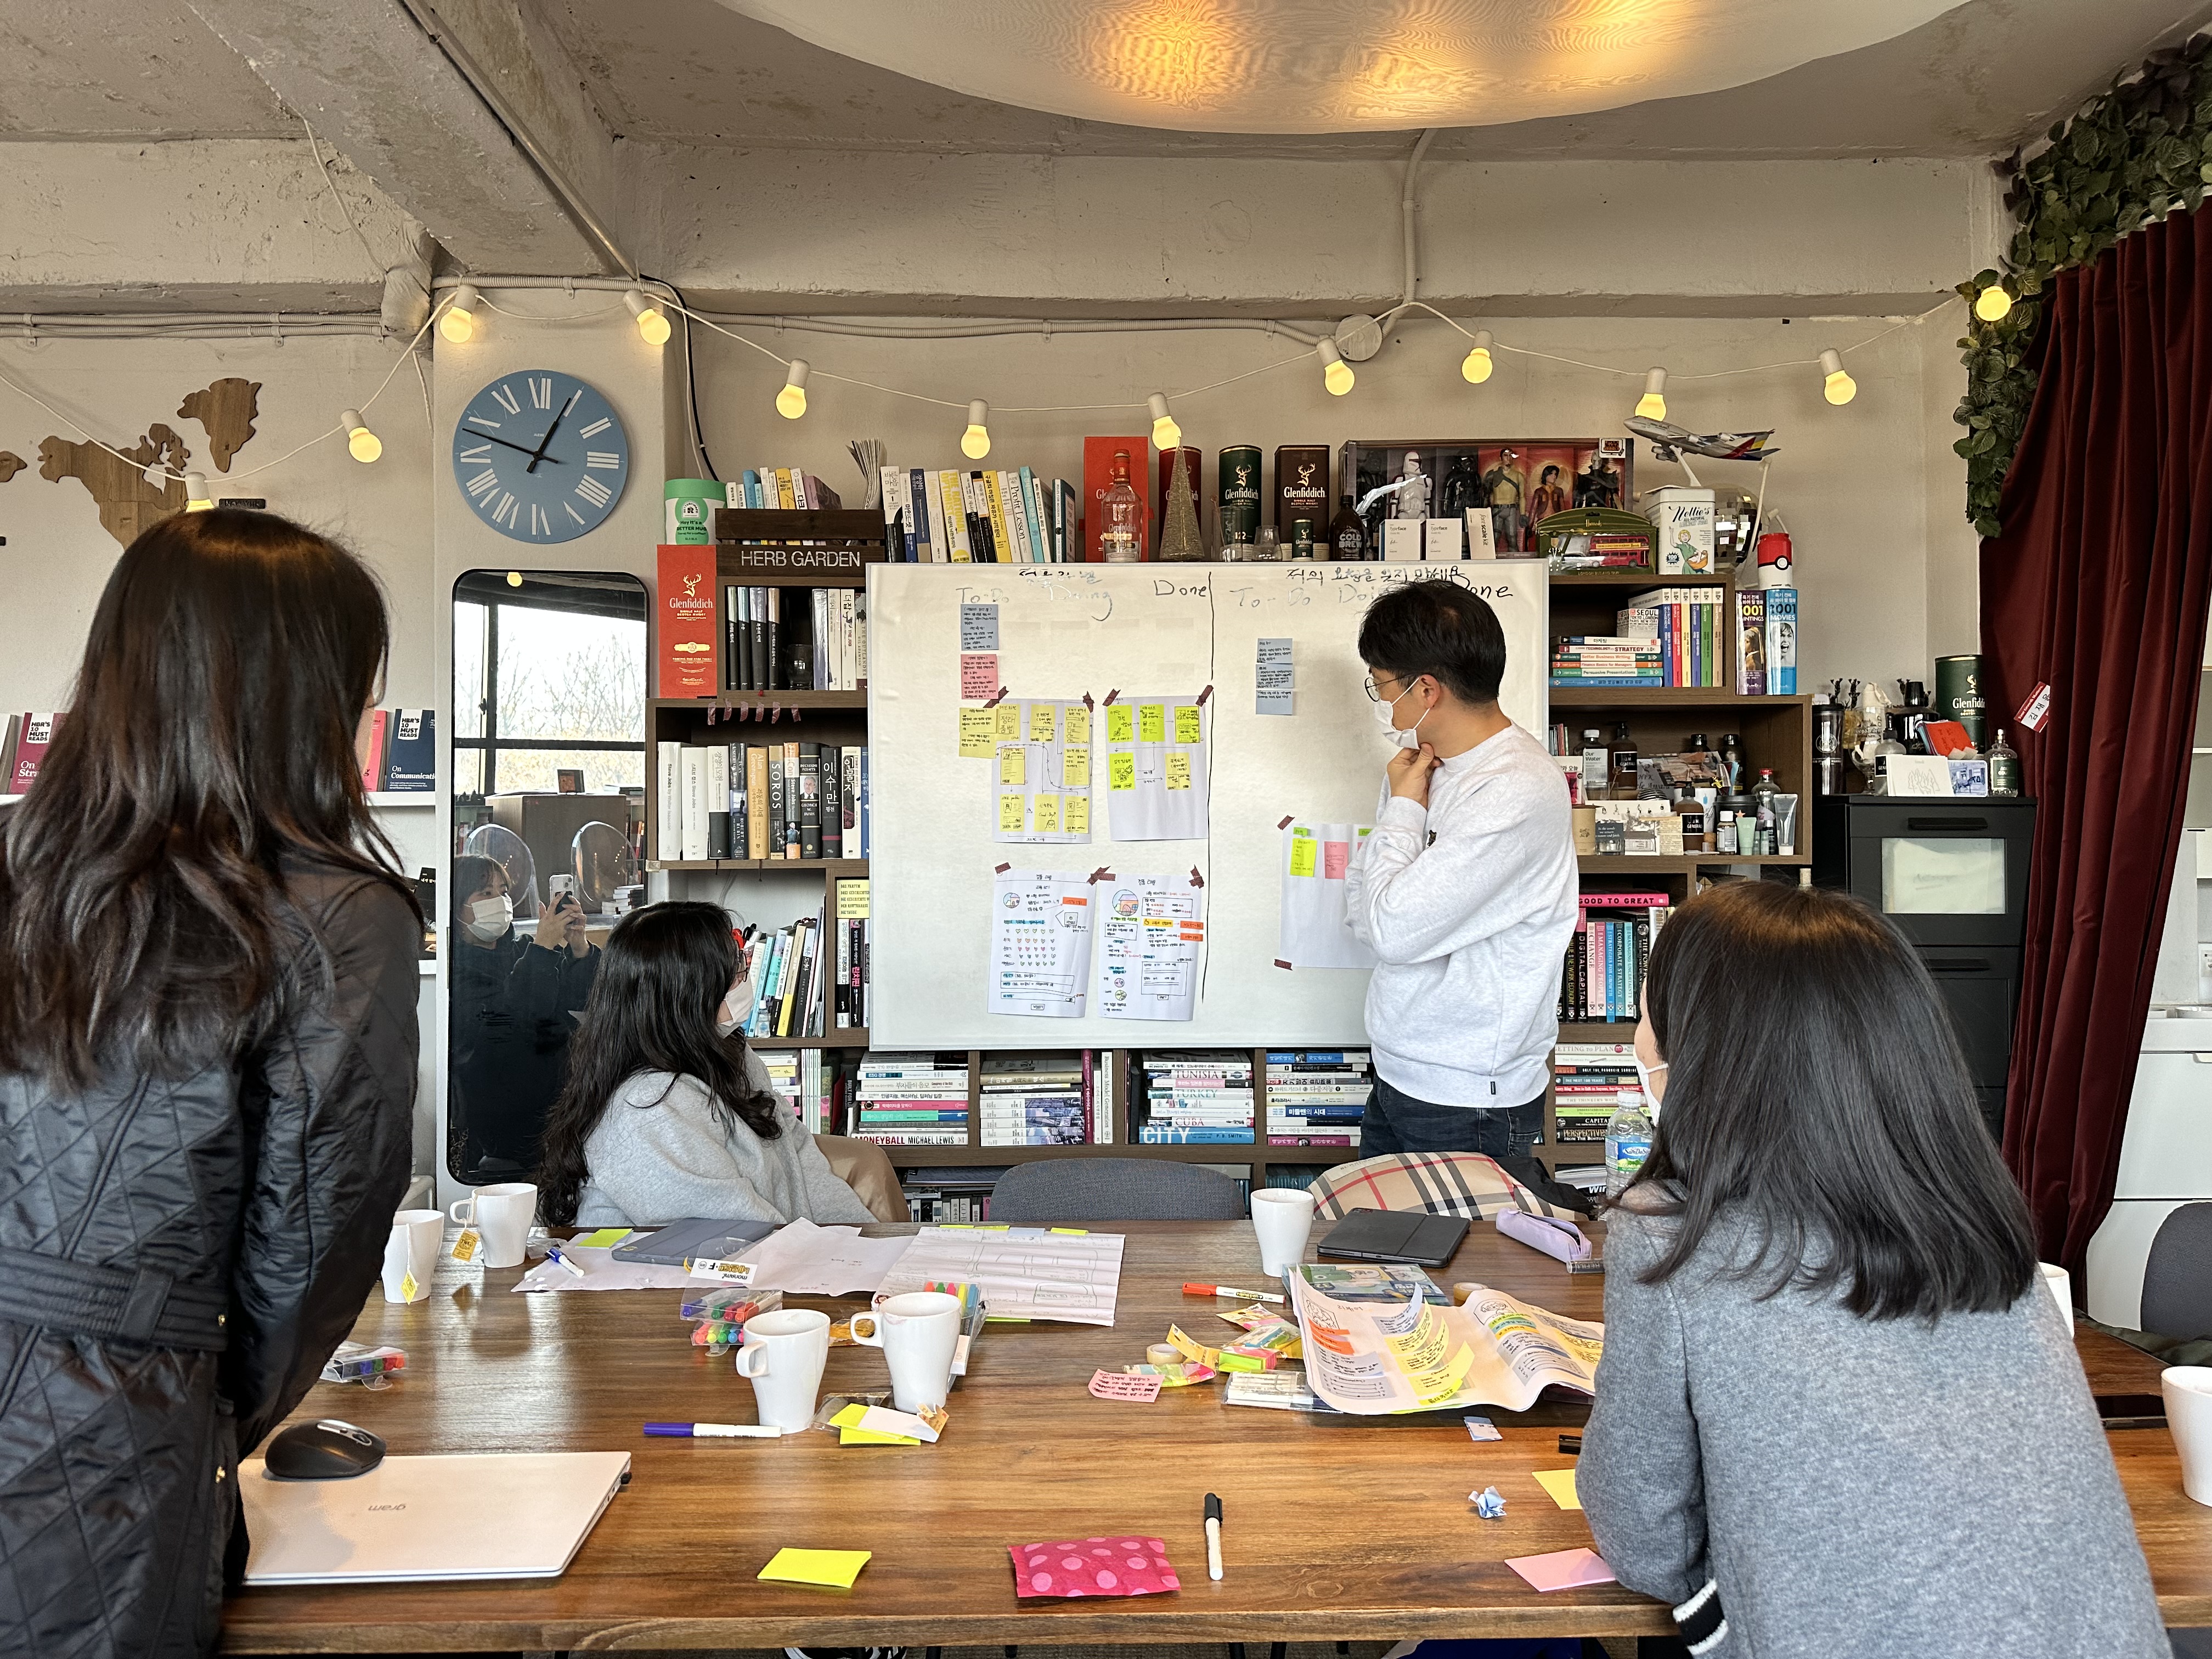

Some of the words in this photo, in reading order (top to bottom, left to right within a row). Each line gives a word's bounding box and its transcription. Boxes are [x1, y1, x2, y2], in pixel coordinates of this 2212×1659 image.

[950, 471, 958, 488] THE
[941, 472, 955, 516] OPTIMIST
[1011, 486, 1020, 509] Profit
[1225, 487, 1259, 500] Glenfiddich
[1284, 487, 1325, 498] Glenfiddich
[952, 491, 965, 533] RATIONAL
[1668, 506, 1711, 523] Nellie's
[1015, 511, 1025, 539] Lesson
[741, 550, 787, 566] HERB
[791, 551, 861, 567] GARDEN
[1154, 580, 1206, 598] Done
[1339, 584, 1374, 603] Doi
[669, 598, 713, 608] Glenfiddich
[20, 760, 35, 769] On
[715, 769, 723, 781] 모험
[823, 762, 839, 804] 이수만
[844, 757, 854, 795] 인물지
[771, 764, 781, 809] SOROS
[1175, 1070, 1218, 1079] TUNISIA
[1175, 1089, 1217, 1098] TURKEY
[1175, 1118, 1205, 1126] CUBA
[908, 1136, 934, 1144] MICHAEL
[936, 1136, 954, 1144] LEWIS
[1143, 1127, 1189, 1144] CITY
[368, 1503, 406, 1513] gram
